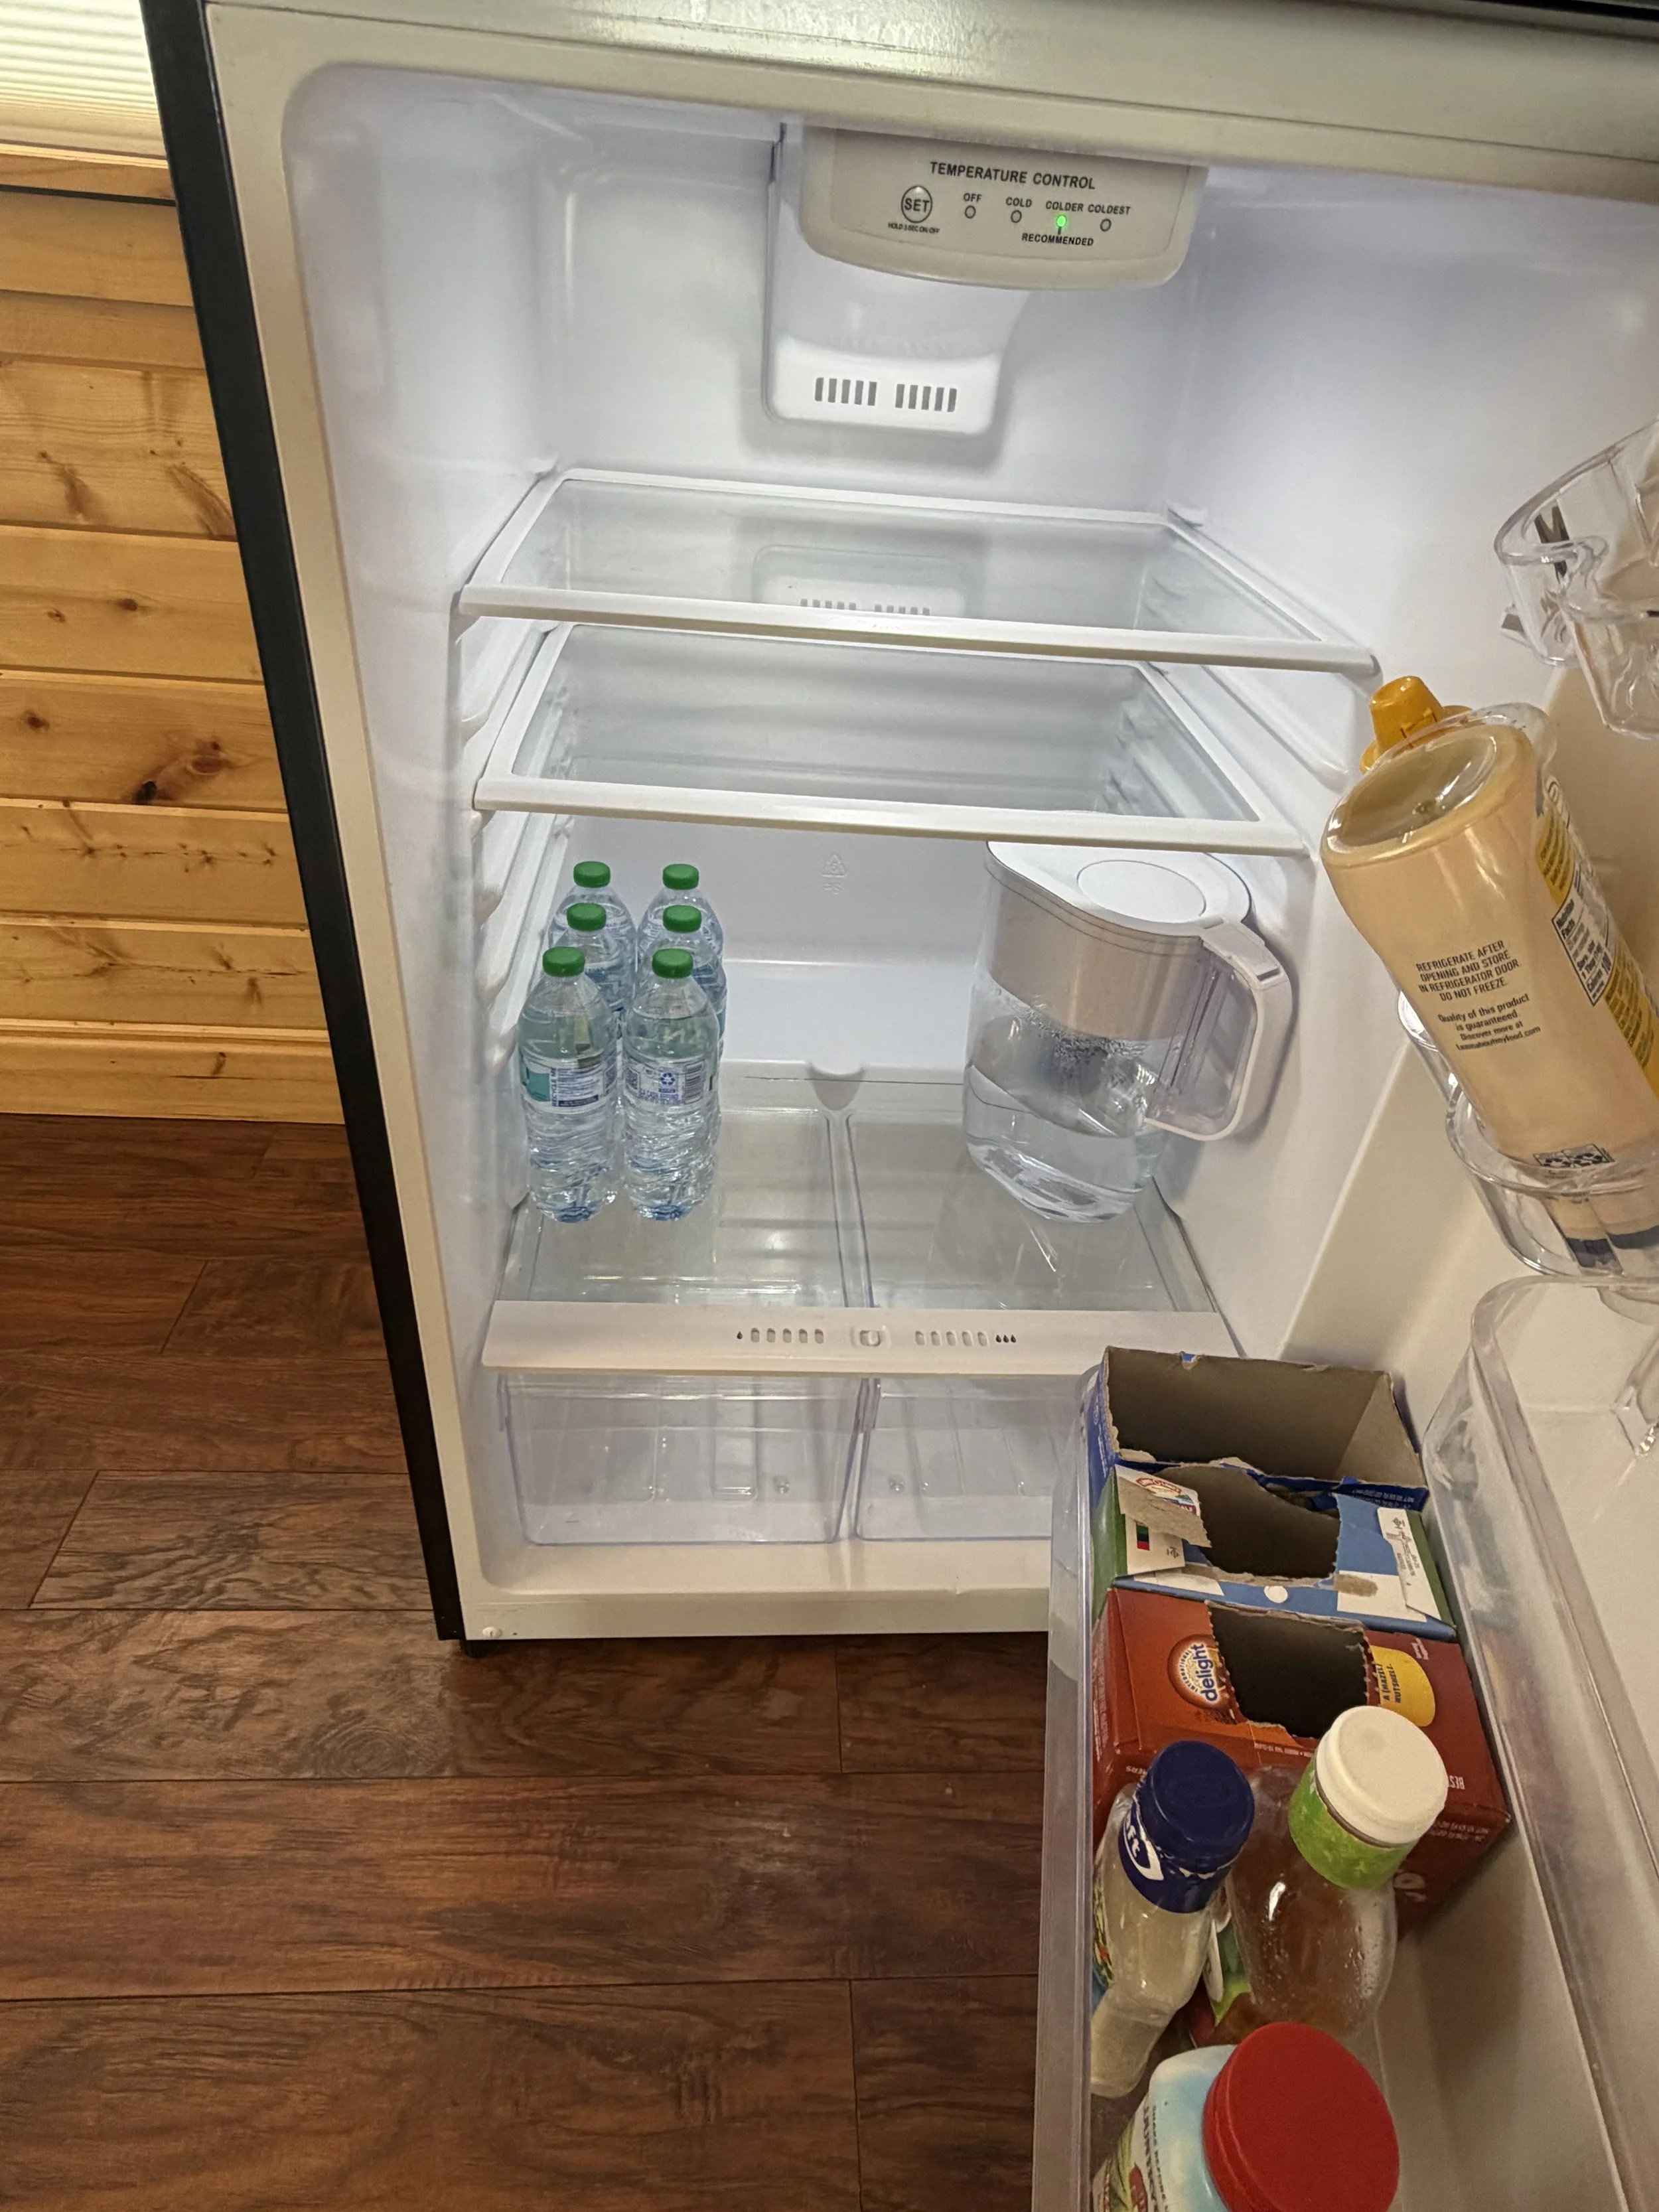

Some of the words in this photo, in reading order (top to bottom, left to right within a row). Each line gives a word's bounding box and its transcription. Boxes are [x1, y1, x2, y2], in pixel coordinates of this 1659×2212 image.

[930, 161, 1027, 184] TEMPERATURE
[1033, 173, 1096, 190] CONTROL
[964, 192, 982, 202] OFF
[1005, 197, 1033, 208] COLD
[904, 198, 930, 212] SET
[1045, 200, 1084, 212] COLDER
[1088, 203, 1131, 215] COLDEST
[1022, 233, 1094, 246] RECOMMENDED
[1416, 950, 1475, 972] REFRIGERATE
[1477, 940, 1505, 958] AFTER
[1420, 968, 1459, 982] OPENING
[1461, 962, 1480, 975] AND
[1481, 950, 1510, 968] STORE
[1419, 984, 1429, 993] IN
[1429, 970, 1493, 992] REFRIGERATOR
[1439, 992, 1453, 1001] DO
[1454, 988, 1471, 999] NOT
[1438, 1013, 1466, 1023] Quality
[1468, 1009, 1477, 1019] of
[1479, 1007, 1495, 1017] this
[1497, 993, 1530, 1013] product
[1460, 1030, 1491, 1041] Discover
[1493, 1025, 1514, 1034] more
[1179, 1650, 1198, 1692] INTERNATIONAL
[1190, 1643, 1218, 1701] delight
[1448, 1775, 1465, 1790] BES
